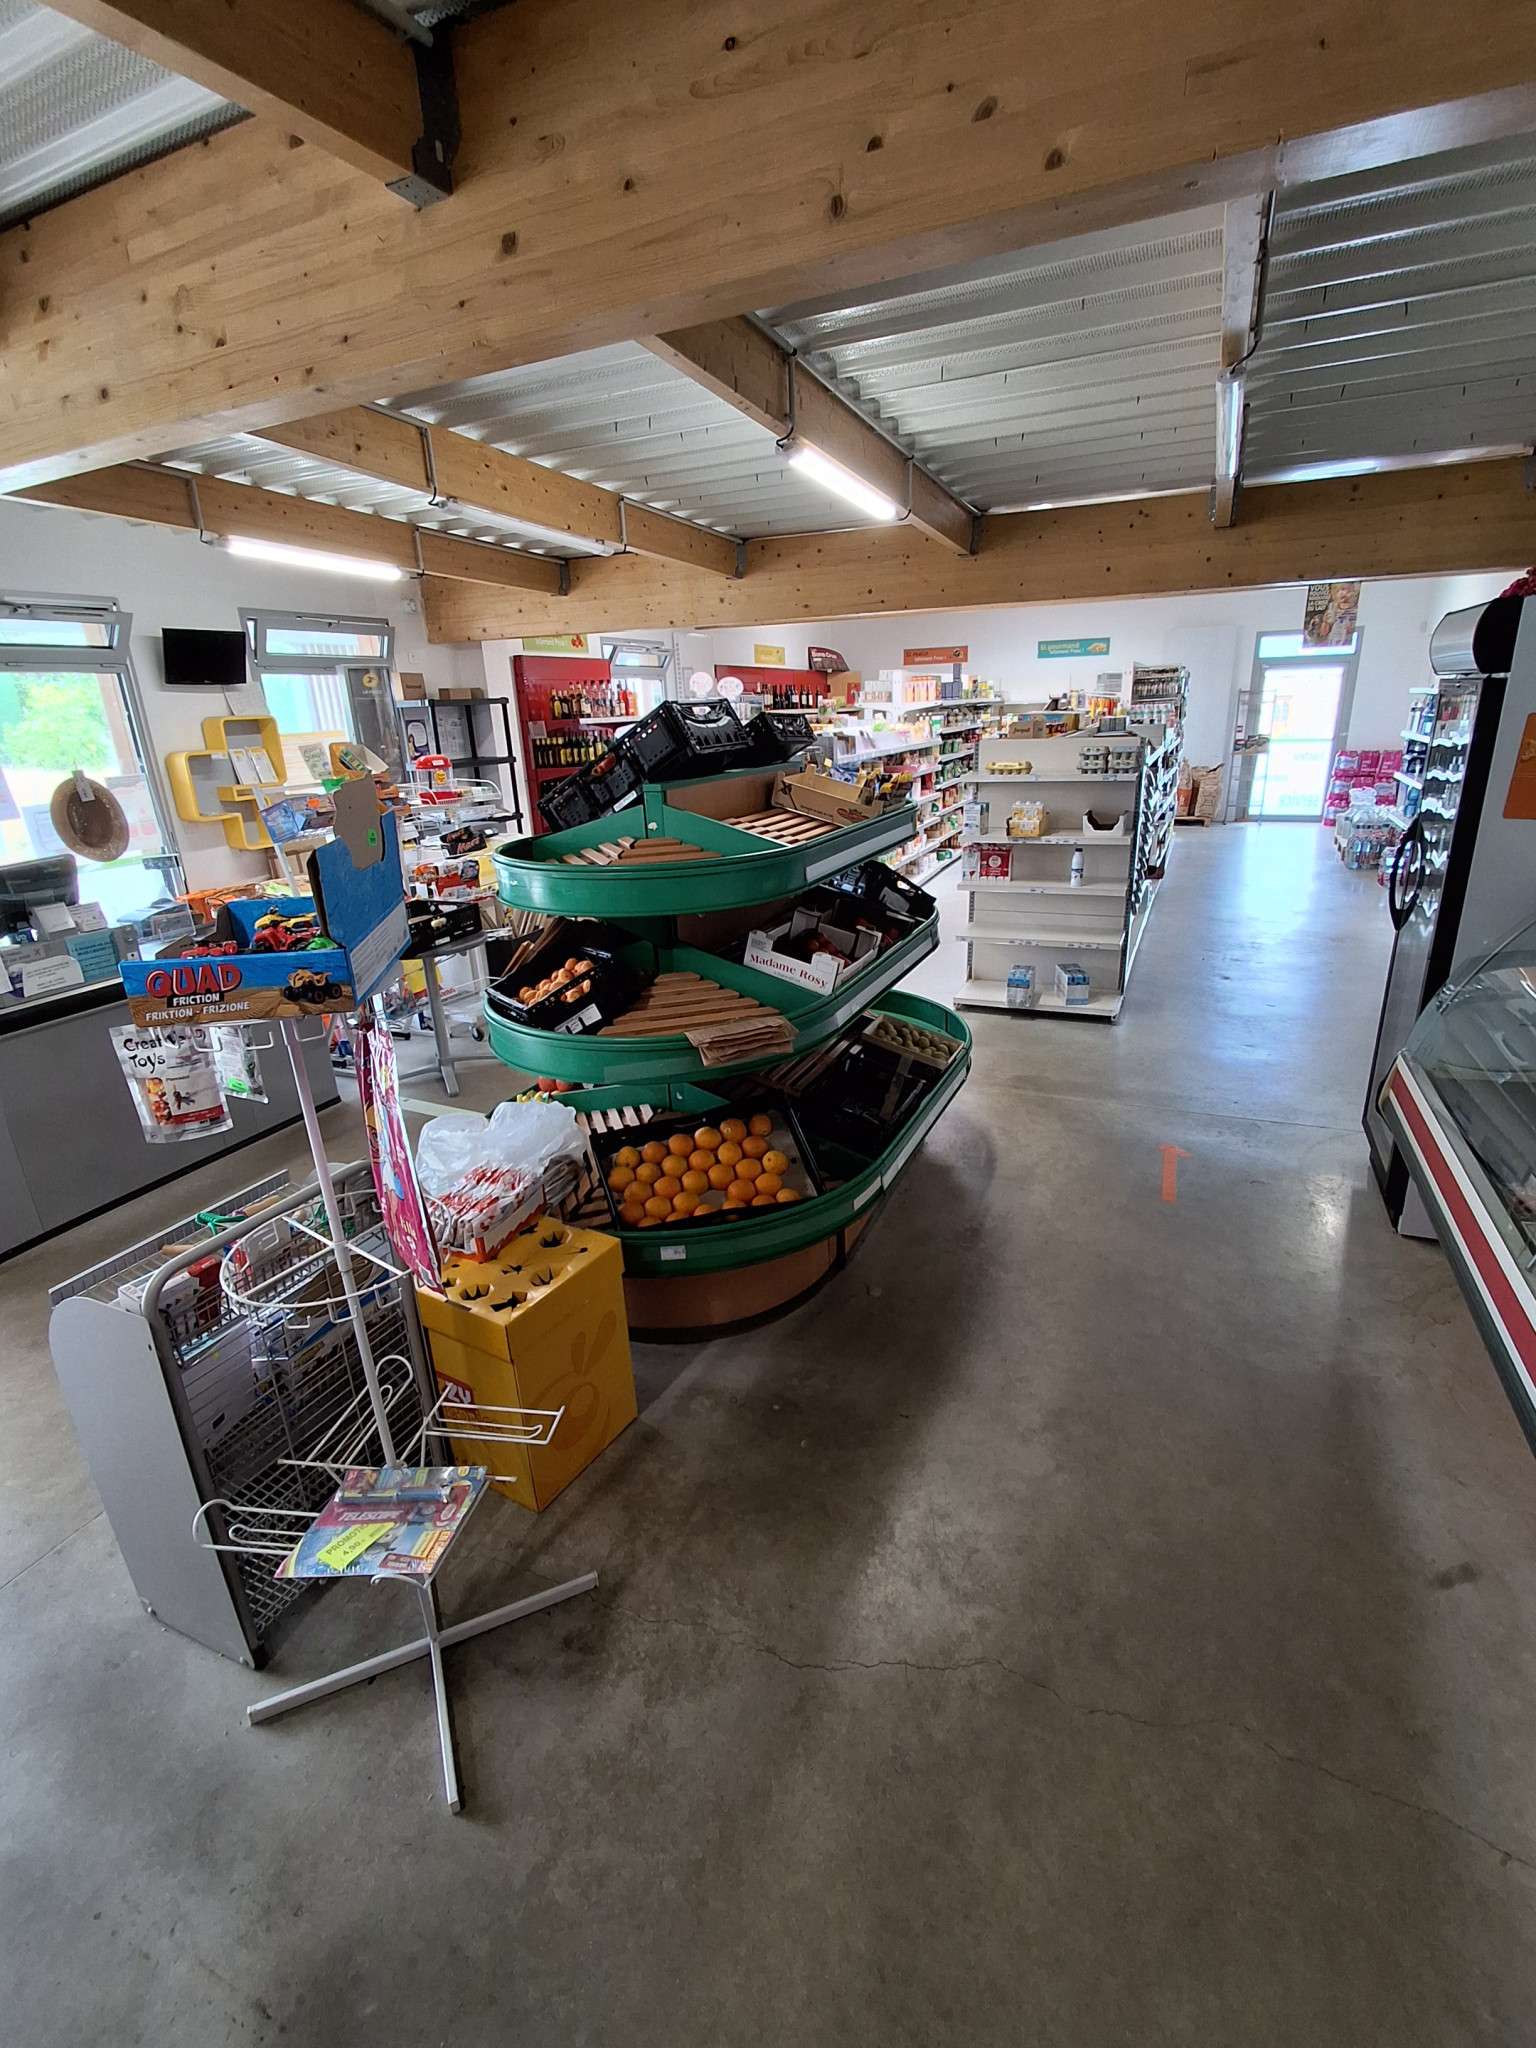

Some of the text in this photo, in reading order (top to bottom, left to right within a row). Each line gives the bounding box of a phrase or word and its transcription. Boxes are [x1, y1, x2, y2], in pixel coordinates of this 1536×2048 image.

[145, 962, 243, 999] QUAD
[750, 953, 828, 989] Madame Rosy
[172, 993, 221, 1007] FRICTION
[144, 1008, 193, 1022] FRIKTION
[203, 1001, 251, 1014] FRIZIONE
[123, 1029, 187, 1052] Creatve
[128, 1052, 166, 1074] Toys
